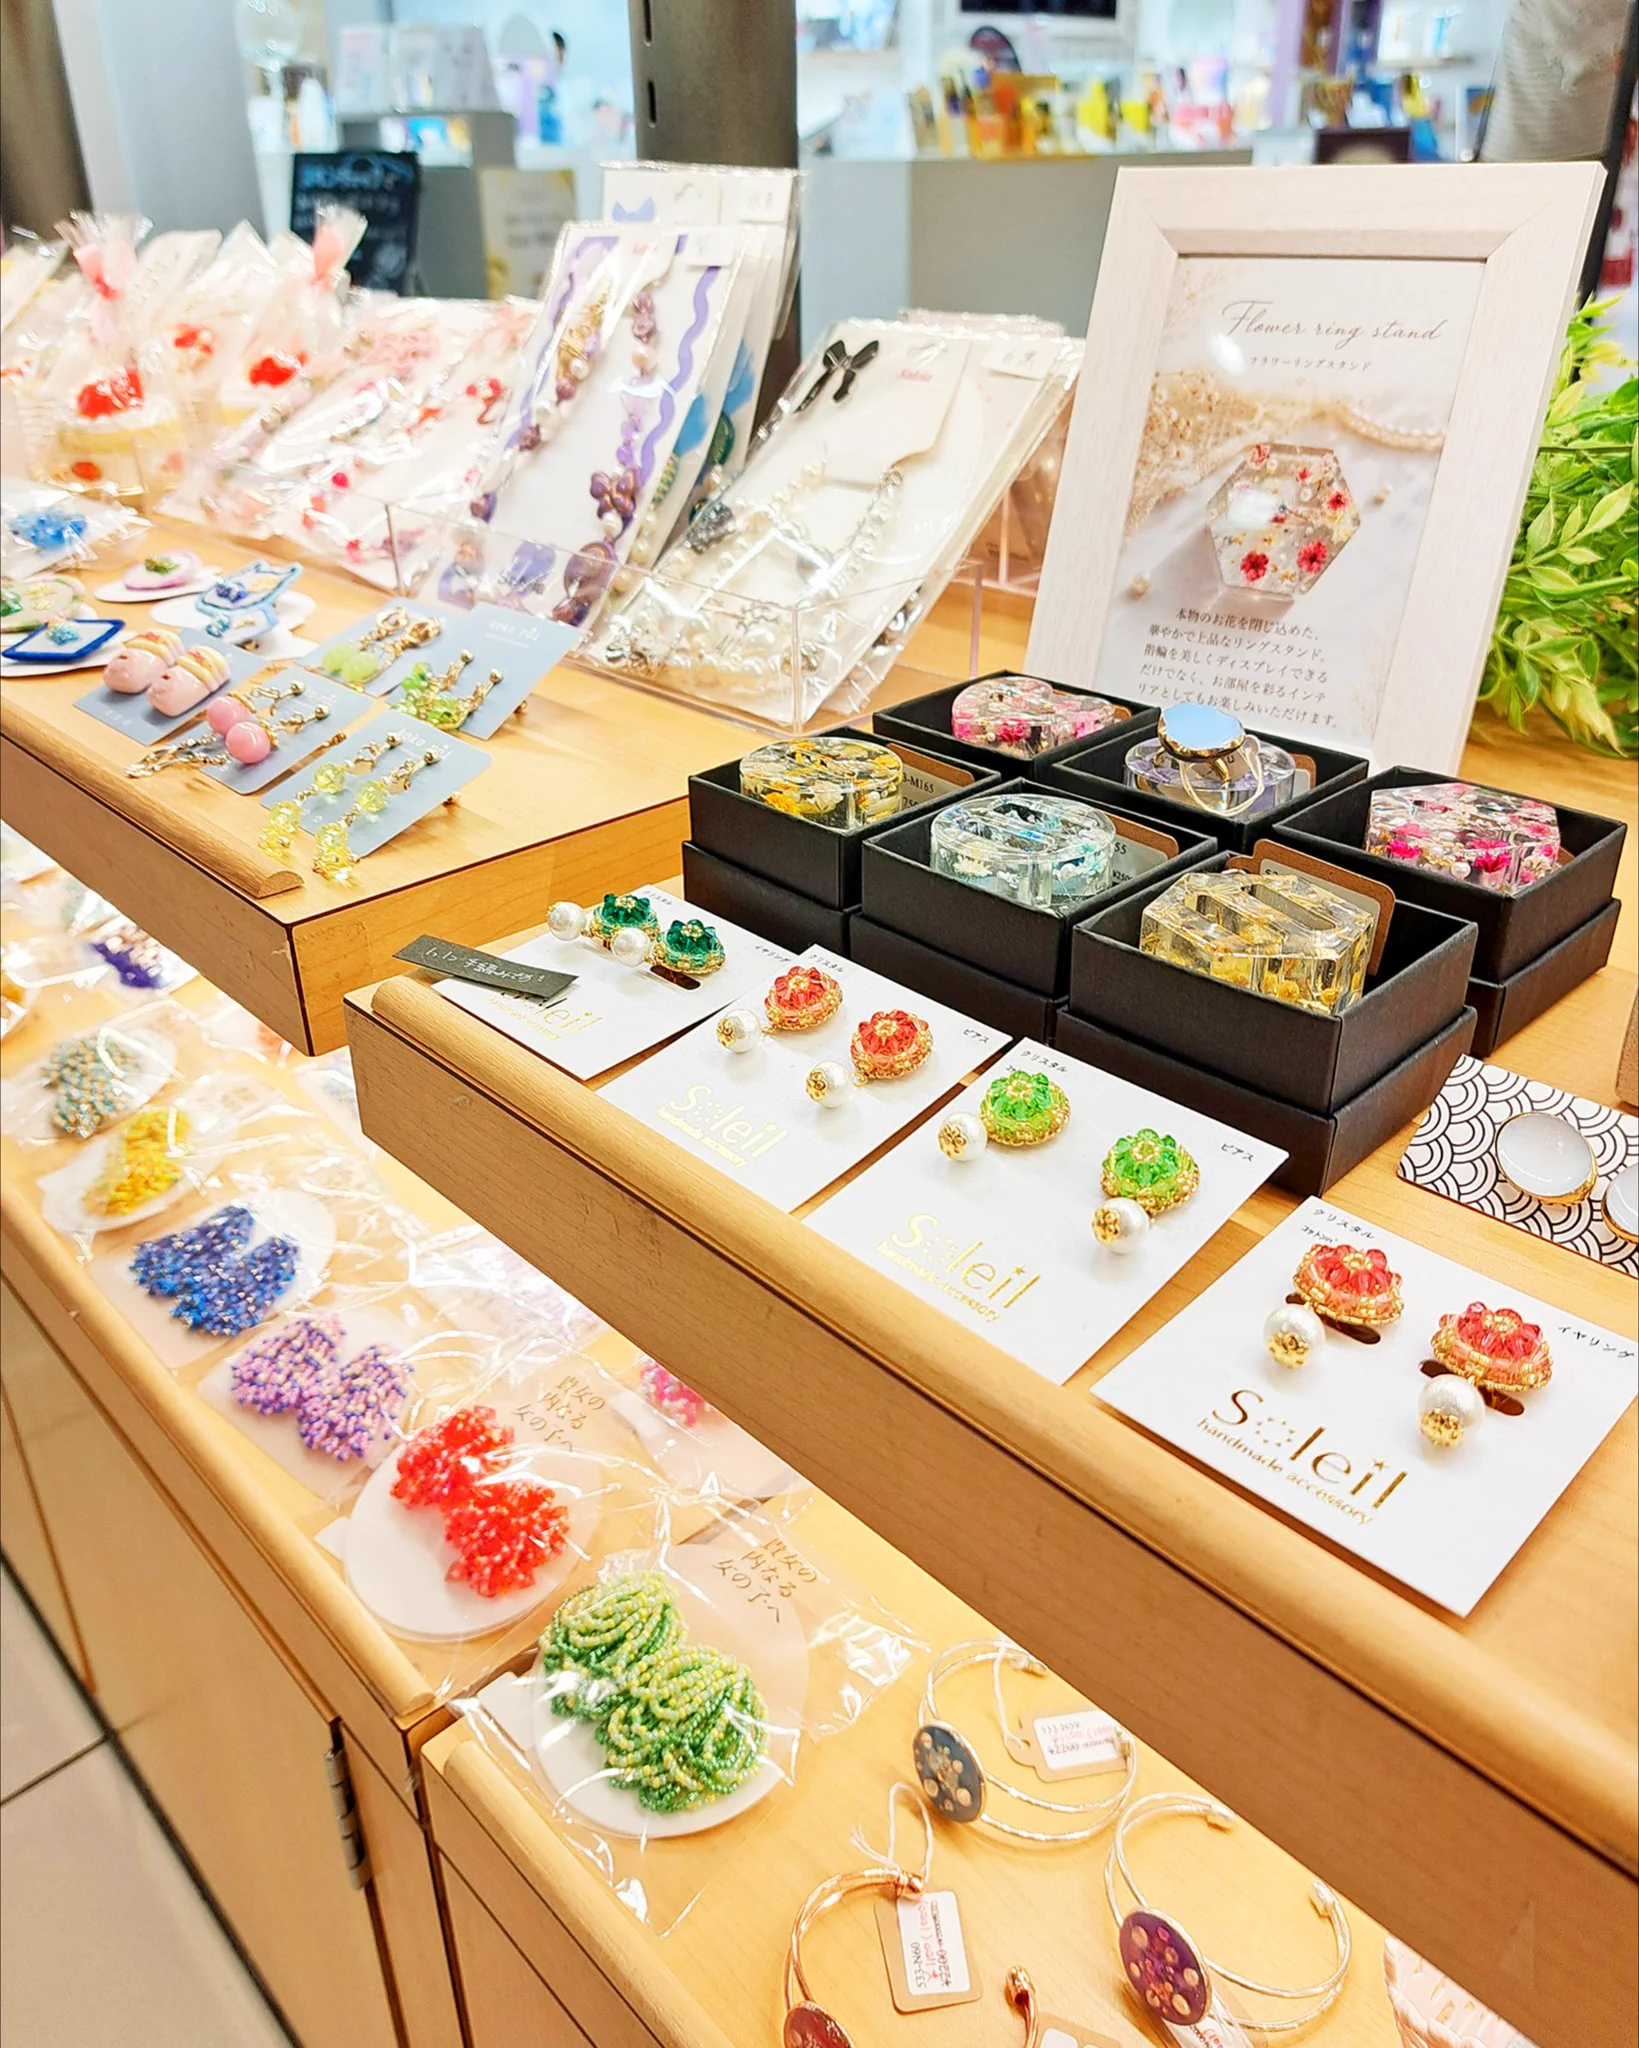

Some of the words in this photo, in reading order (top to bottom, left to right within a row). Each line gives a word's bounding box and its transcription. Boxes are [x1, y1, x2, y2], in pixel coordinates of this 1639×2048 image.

[1222, 301, 1307, 337] Flower
[1314, 321, 1364, 350] ring
[1371, 319, 1448, 340] stand
[1250, 356, 1371, 372] フラワーリングスタンド
[1149, 623, 1326, 663] 華やかで上品なリングスタンド。
[1176, 607, 1320, 641] 本物のお花を閉じ込めた、
[1140, 663, 1327, 703] だけでなく、お部屋を彩るインテ
[1144, 642, 1329, 684] 指輪を美しくディスプレイできる
[1138, 683, 1338, 729] リアとしてもお楽しみいただけます。
[963, 1027, 990, 1044] ピアス
[1021, 1050, 1069, 1074] クリスタル
[669, 1084, 789, 1159] Soleil
[1220, 1142, 1255, 1163] ピアス
[1313, 1208, 1375, 1239] クリスタル
[890, 1213, 1041, 1309] Soleil
[1558, 1326, 1635, 1359] イヤリング
[1211, 1389, 1408, 1510] Soleil
[1197, 1417, 1284, 1473] handmade
[1285, 1470, 1374, 1526] accessory
